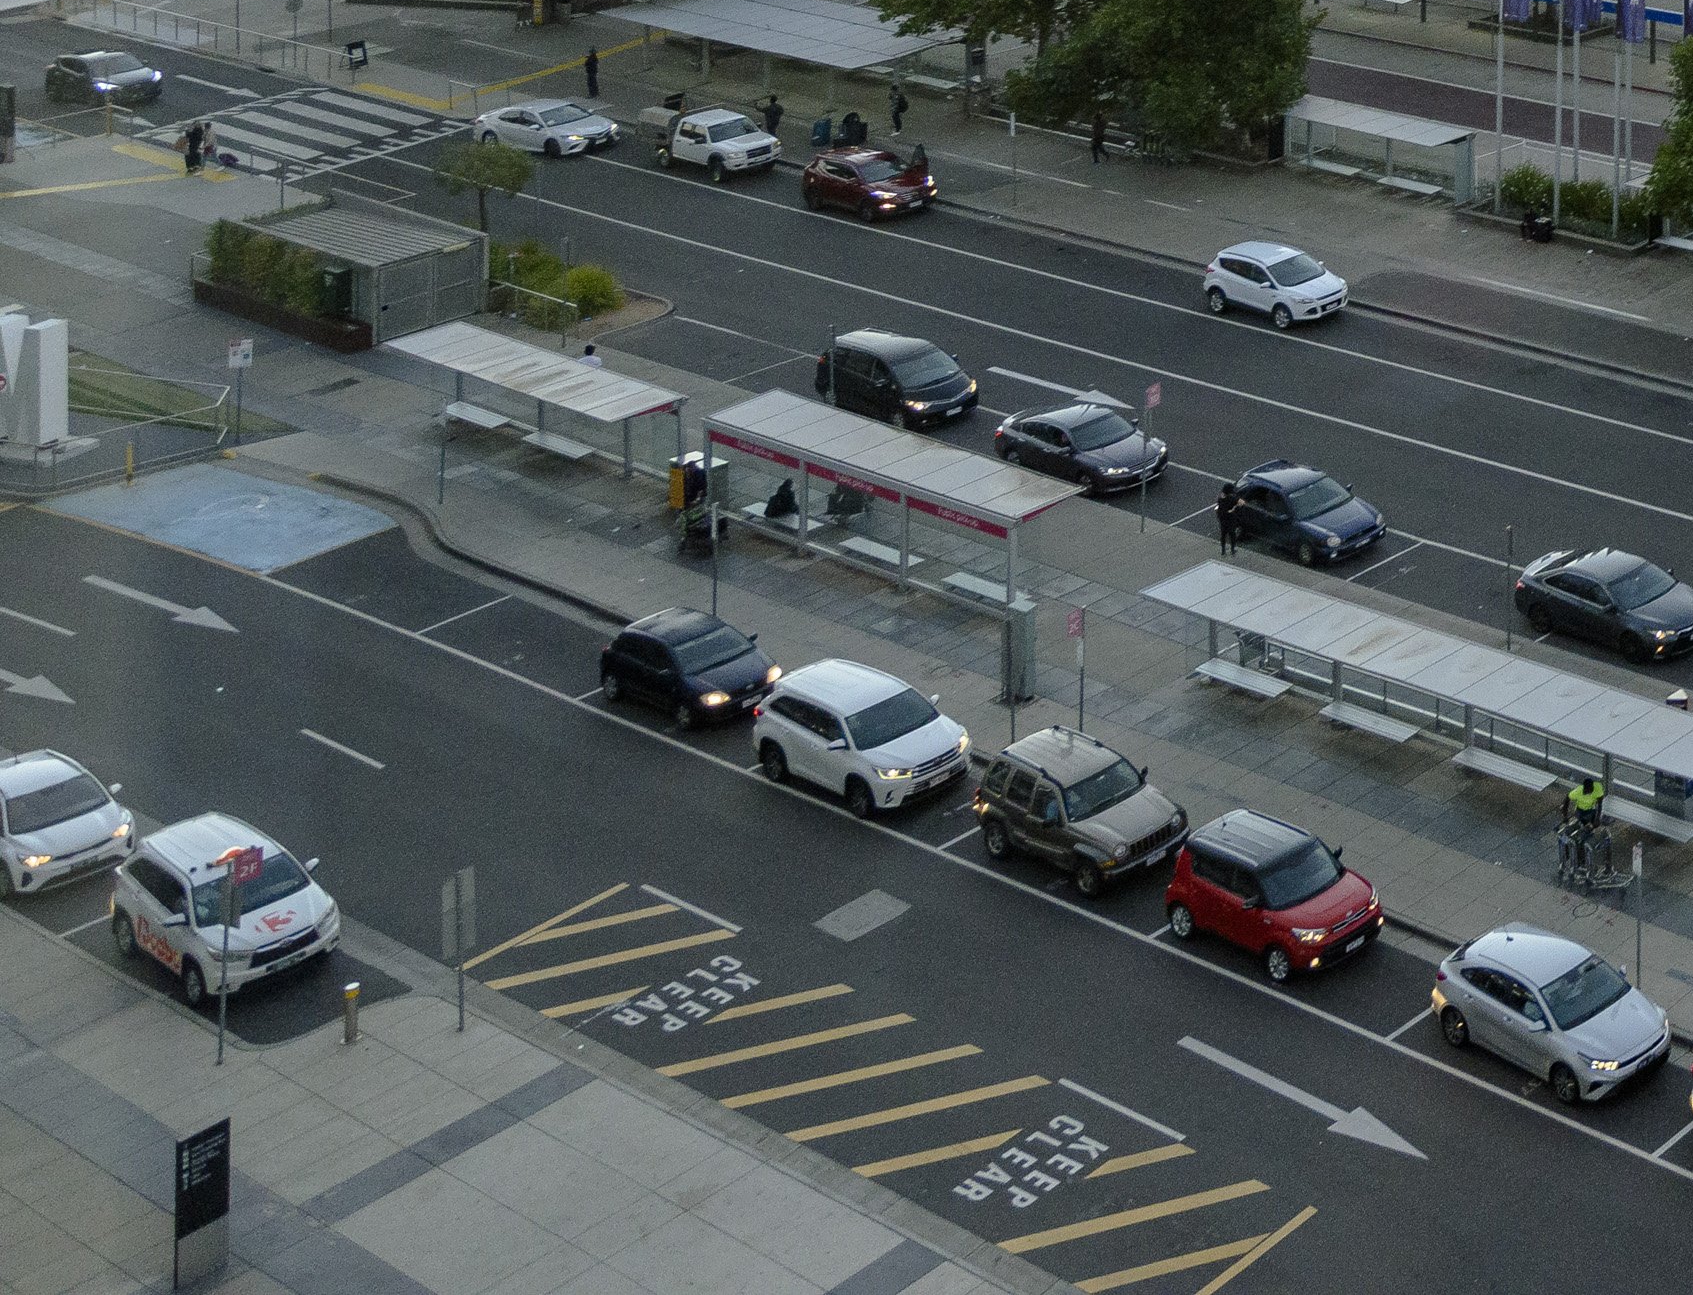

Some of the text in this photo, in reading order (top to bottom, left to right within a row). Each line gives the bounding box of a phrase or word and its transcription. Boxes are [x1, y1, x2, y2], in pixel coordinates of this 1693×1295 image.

[240, 861, 256, 879] 2F
[611, 955, 742, 1026] CLEAR
[661, 972, 761, 1032] KEEP
[952, 1115, 1085, 1201] CLEAR
[1007, 1135, 1110, 1208] KEEP
